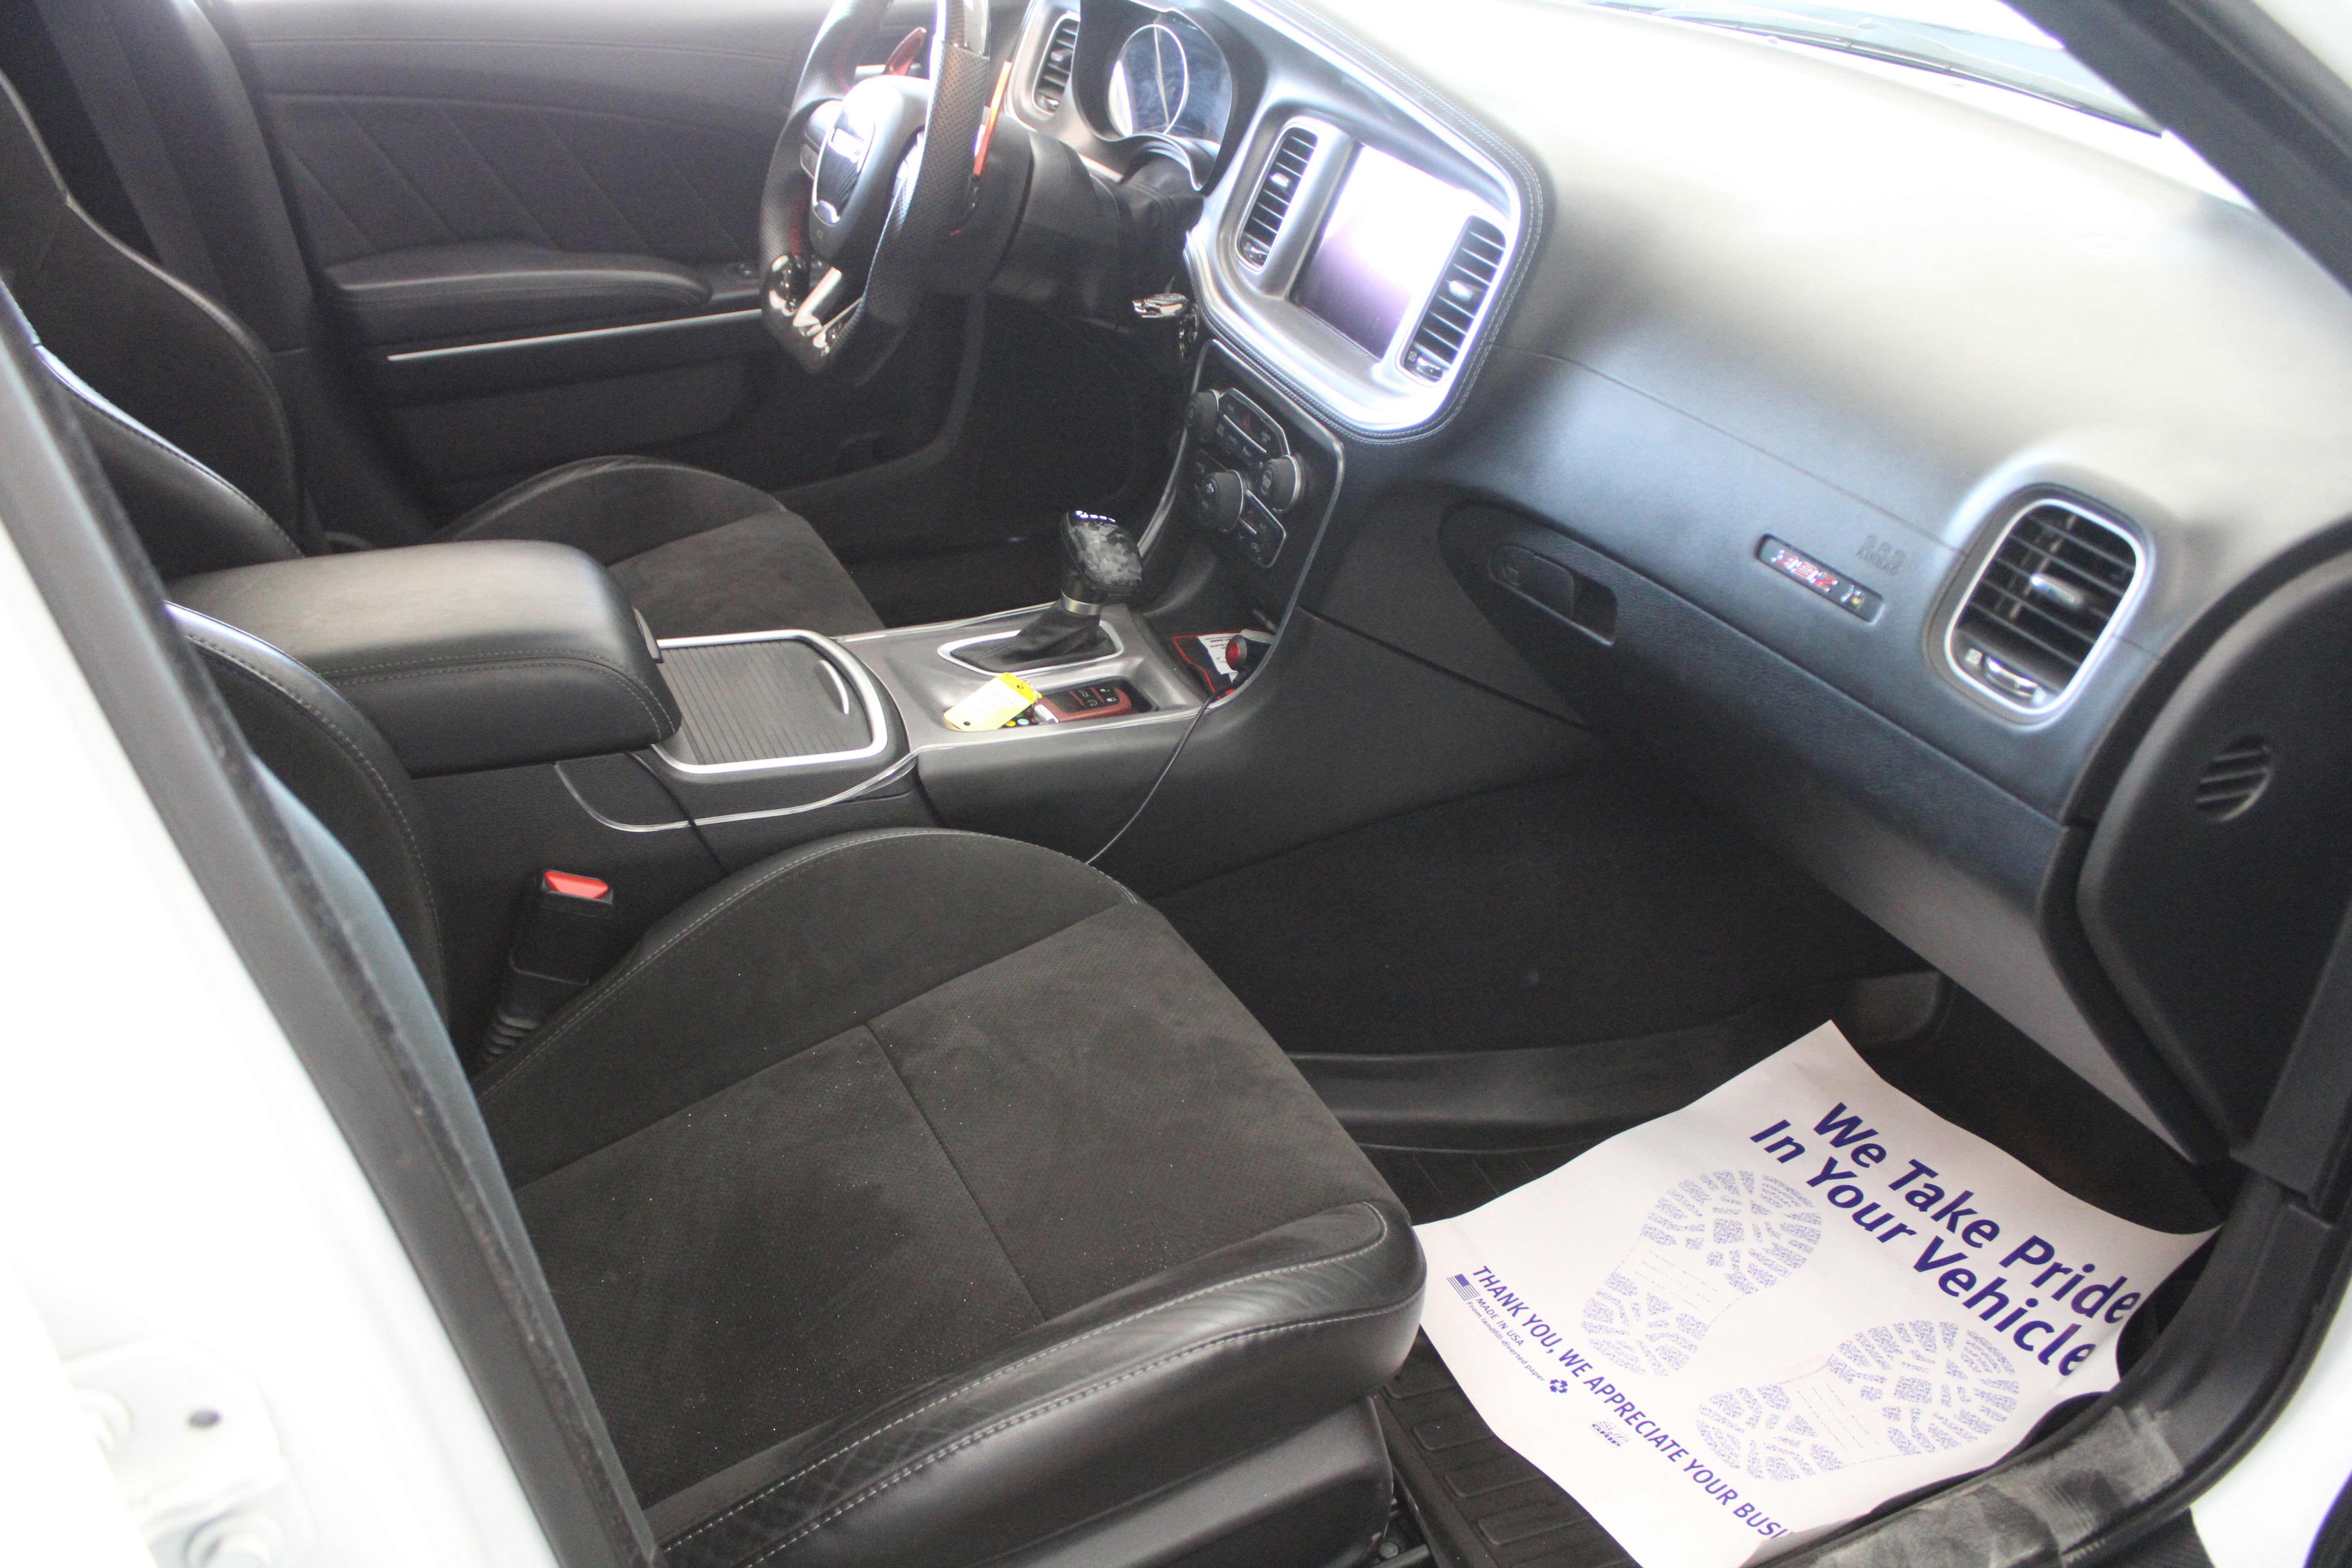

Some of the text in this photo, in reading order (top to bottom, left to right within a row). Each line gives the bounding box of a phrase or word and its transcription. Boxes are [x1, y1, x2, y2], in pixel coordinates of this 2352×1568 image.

[1750, 1119, 2096, 1376] In Your Vehicle
[1813, 1102, 2141, 1324] We Take Pride
[1467, 1301, 1546, 1382] From landfill-diverted paper
[1475, 1298, 1525, 1346] MADE IN USA
[1472, 1265, 1794, 1539] THANK YOU, WE APPRECIATE YOUR BUSI
[1592, 1424, 1621, 1446] GRIP
